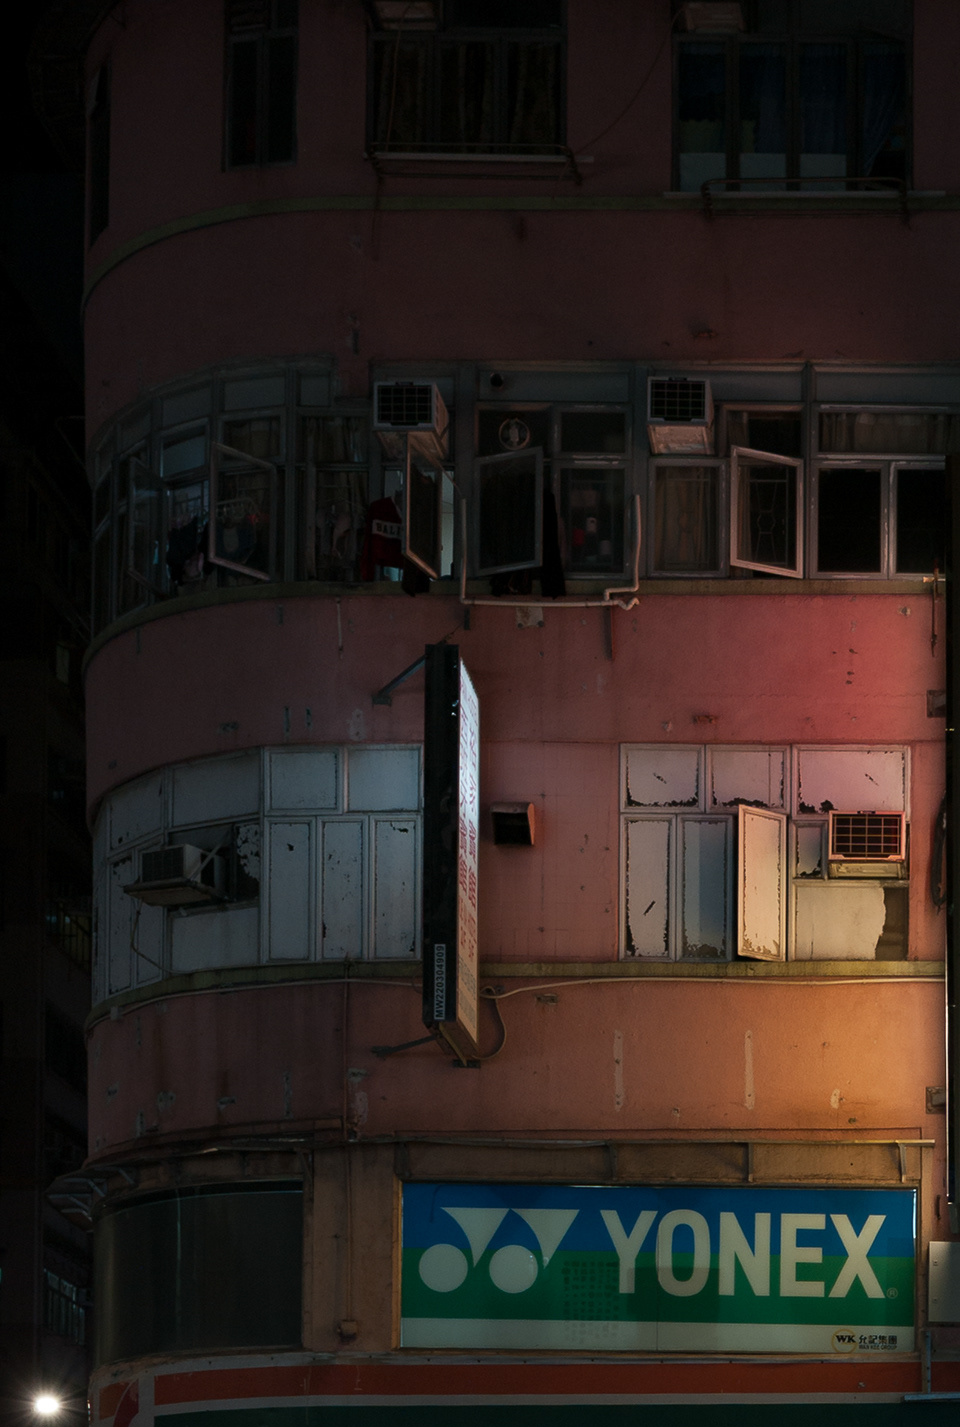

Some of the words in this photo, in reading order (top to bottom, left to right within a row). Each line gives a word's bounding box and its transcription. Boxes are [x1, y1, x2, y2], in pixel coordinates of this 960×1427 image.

[435, 945, 445, 1019] MW220304909
[600, 1208, 888, 1299] YONEX
[836, 1335, 856, 1343] WK
[859, 1335, 898, 1344] 允記集團
